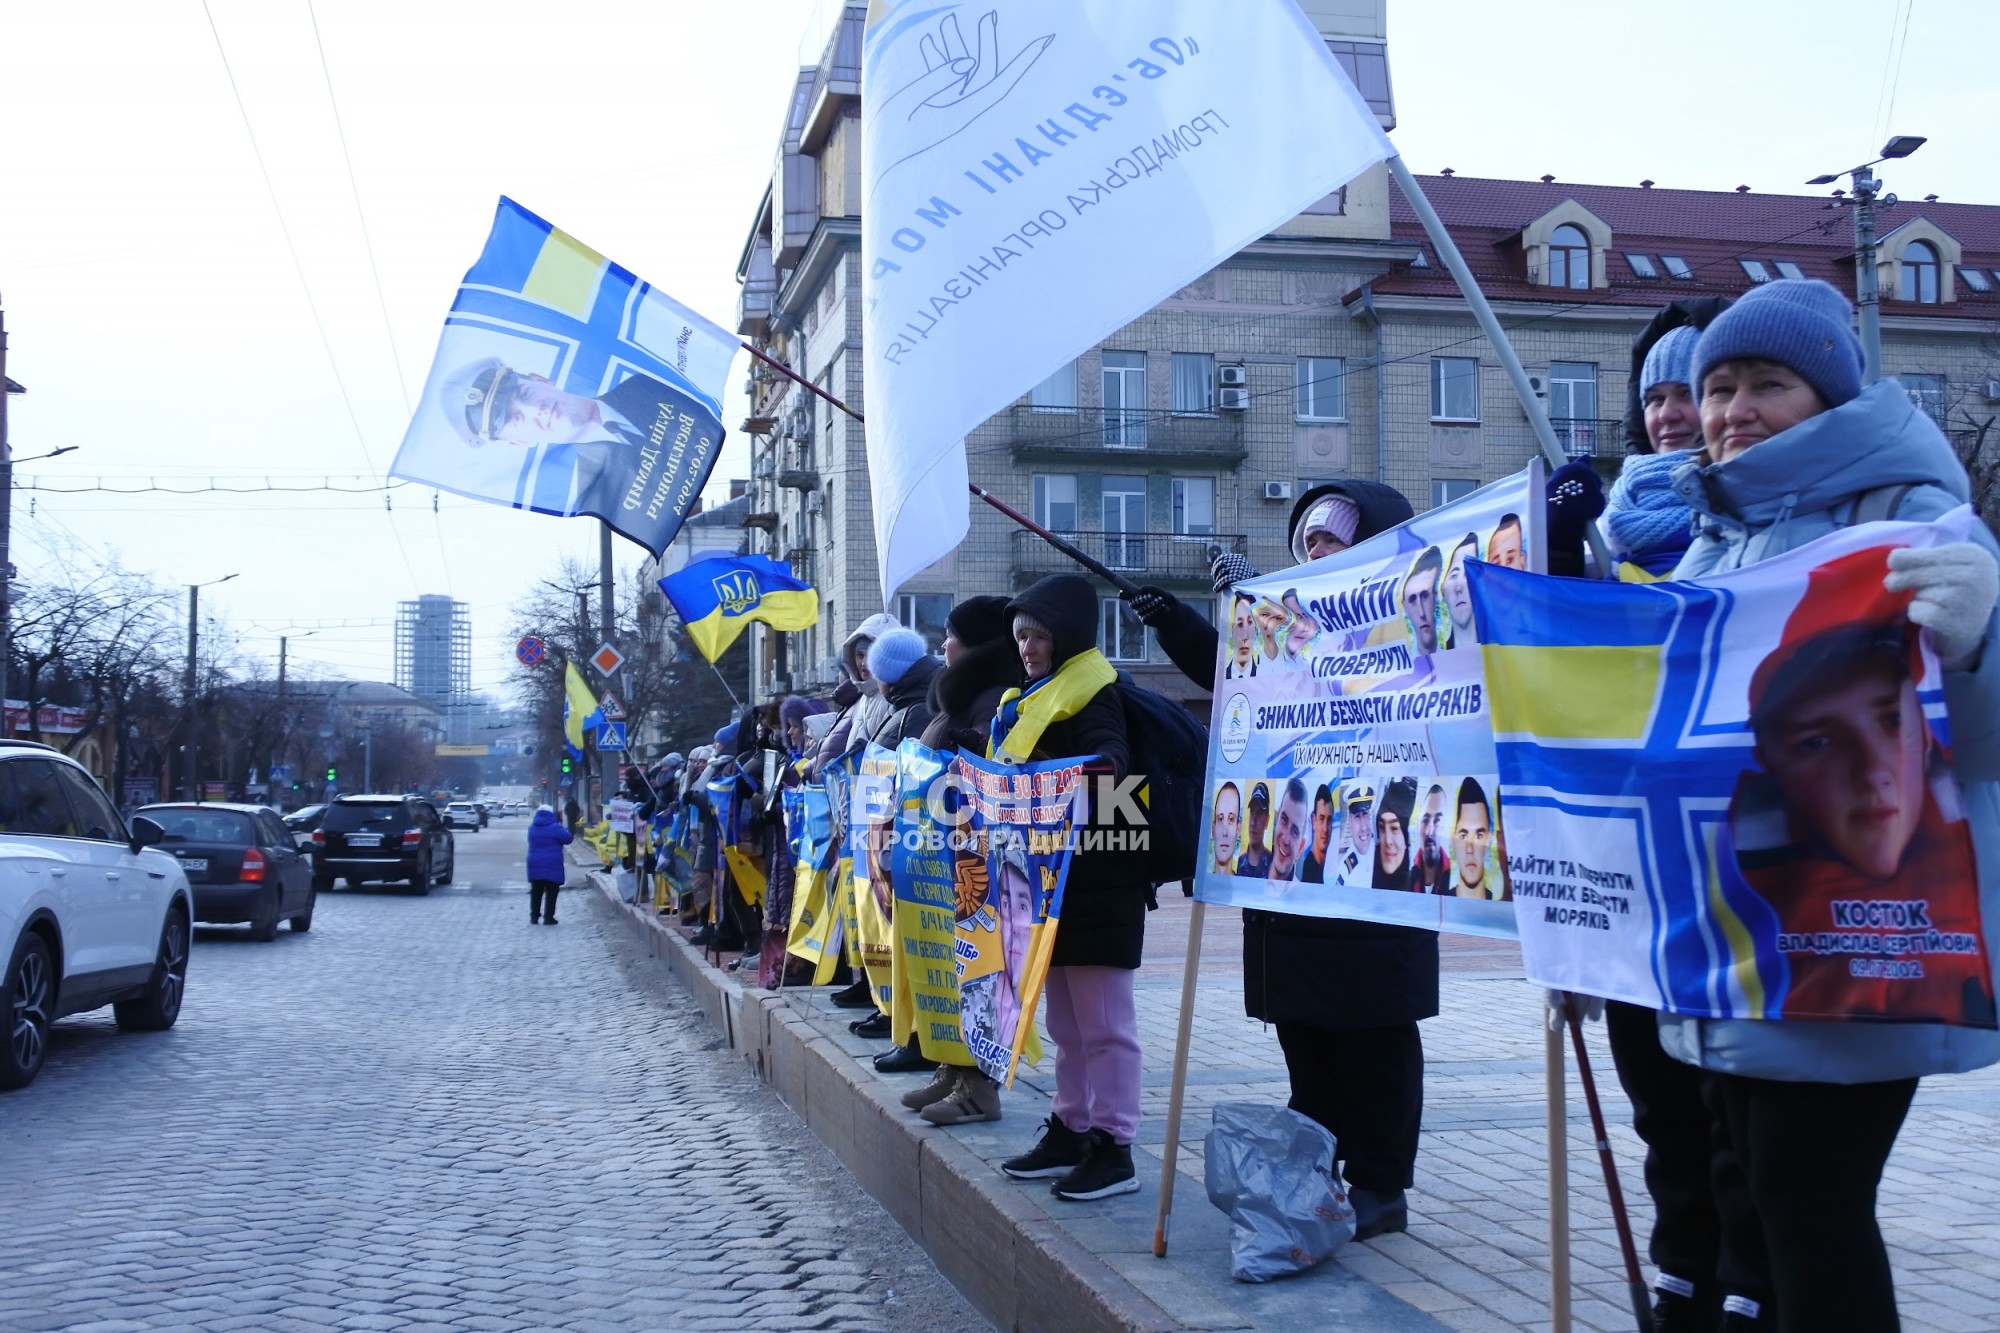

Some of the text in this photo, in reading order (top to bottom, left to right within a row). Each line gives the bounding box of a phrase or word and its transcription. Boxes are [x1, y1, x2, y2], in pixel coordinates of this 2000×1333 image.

[1309, 576, 1400, 633] ЗНАЙТИ
[1318, 644, 1412, 678] ПОВЕРНУТИ
[1255, 684, 1482, 730] ЗНИКЛИХ БЕЗВІСТИ МОРЯКІВ
[1306, 745, 1363, 764] МУЖНІСТЬ
[1366, 744, 1401, 763] НАША
[1400, 742, 1429, 762] СИЛА
[1012, 766, 1084, 800] 30.07.202
[1508, 854, 1555, 876] НАЙТИ
[1559, 860, 1577, 878] ТА
[1513, 879, 1577, 902] НИКЛИХ
[1544, 906, 1610, 931] МОРЯКІВ
[1776, 932, 1881, 955] ВЛАДИСЛАВ
